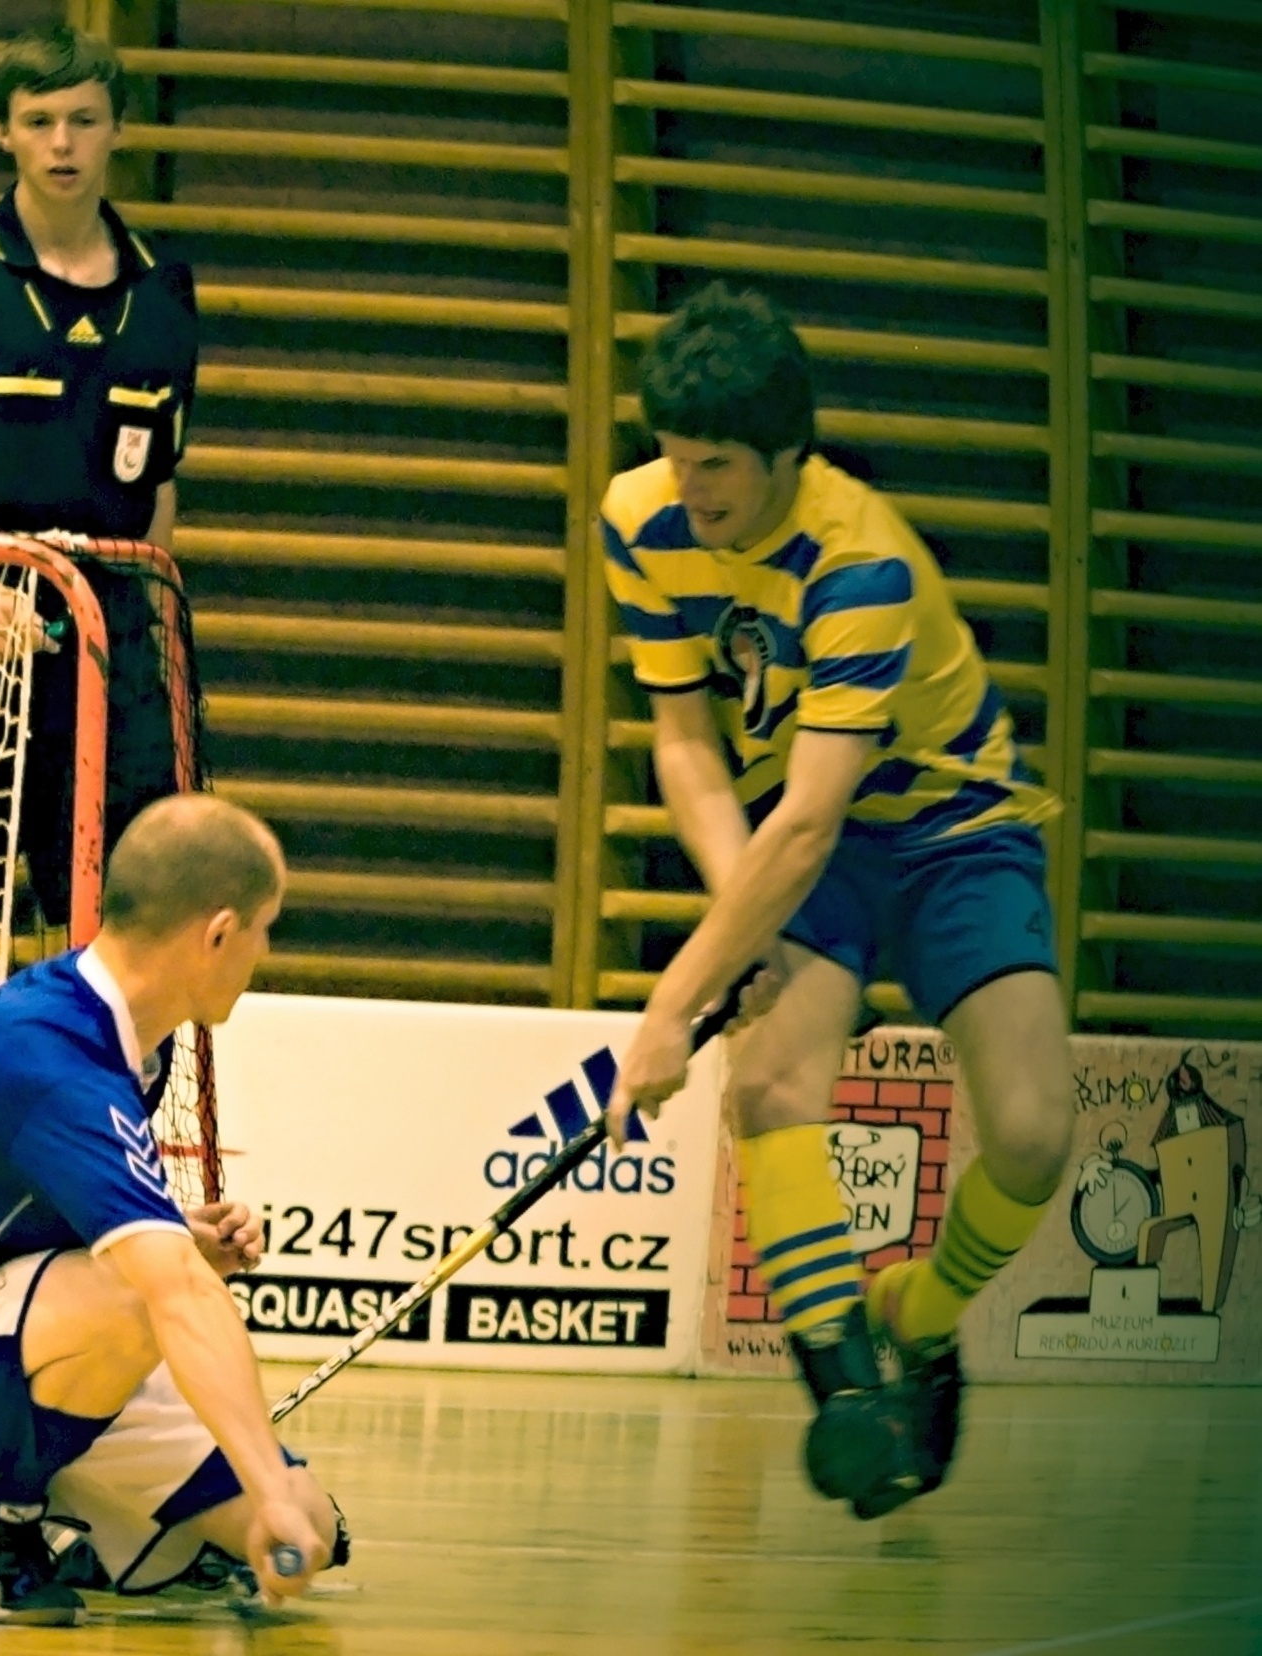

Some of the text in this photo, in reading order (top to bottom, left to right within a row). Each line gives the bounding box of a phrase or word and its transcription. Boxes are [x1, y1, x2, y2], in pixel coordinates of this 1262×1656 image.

[467, 1297, 646, 1342] BASKET
[1091, 1314, 1154, 1331] MUZEUM
[1112, 1337, 1123, 1350] A
